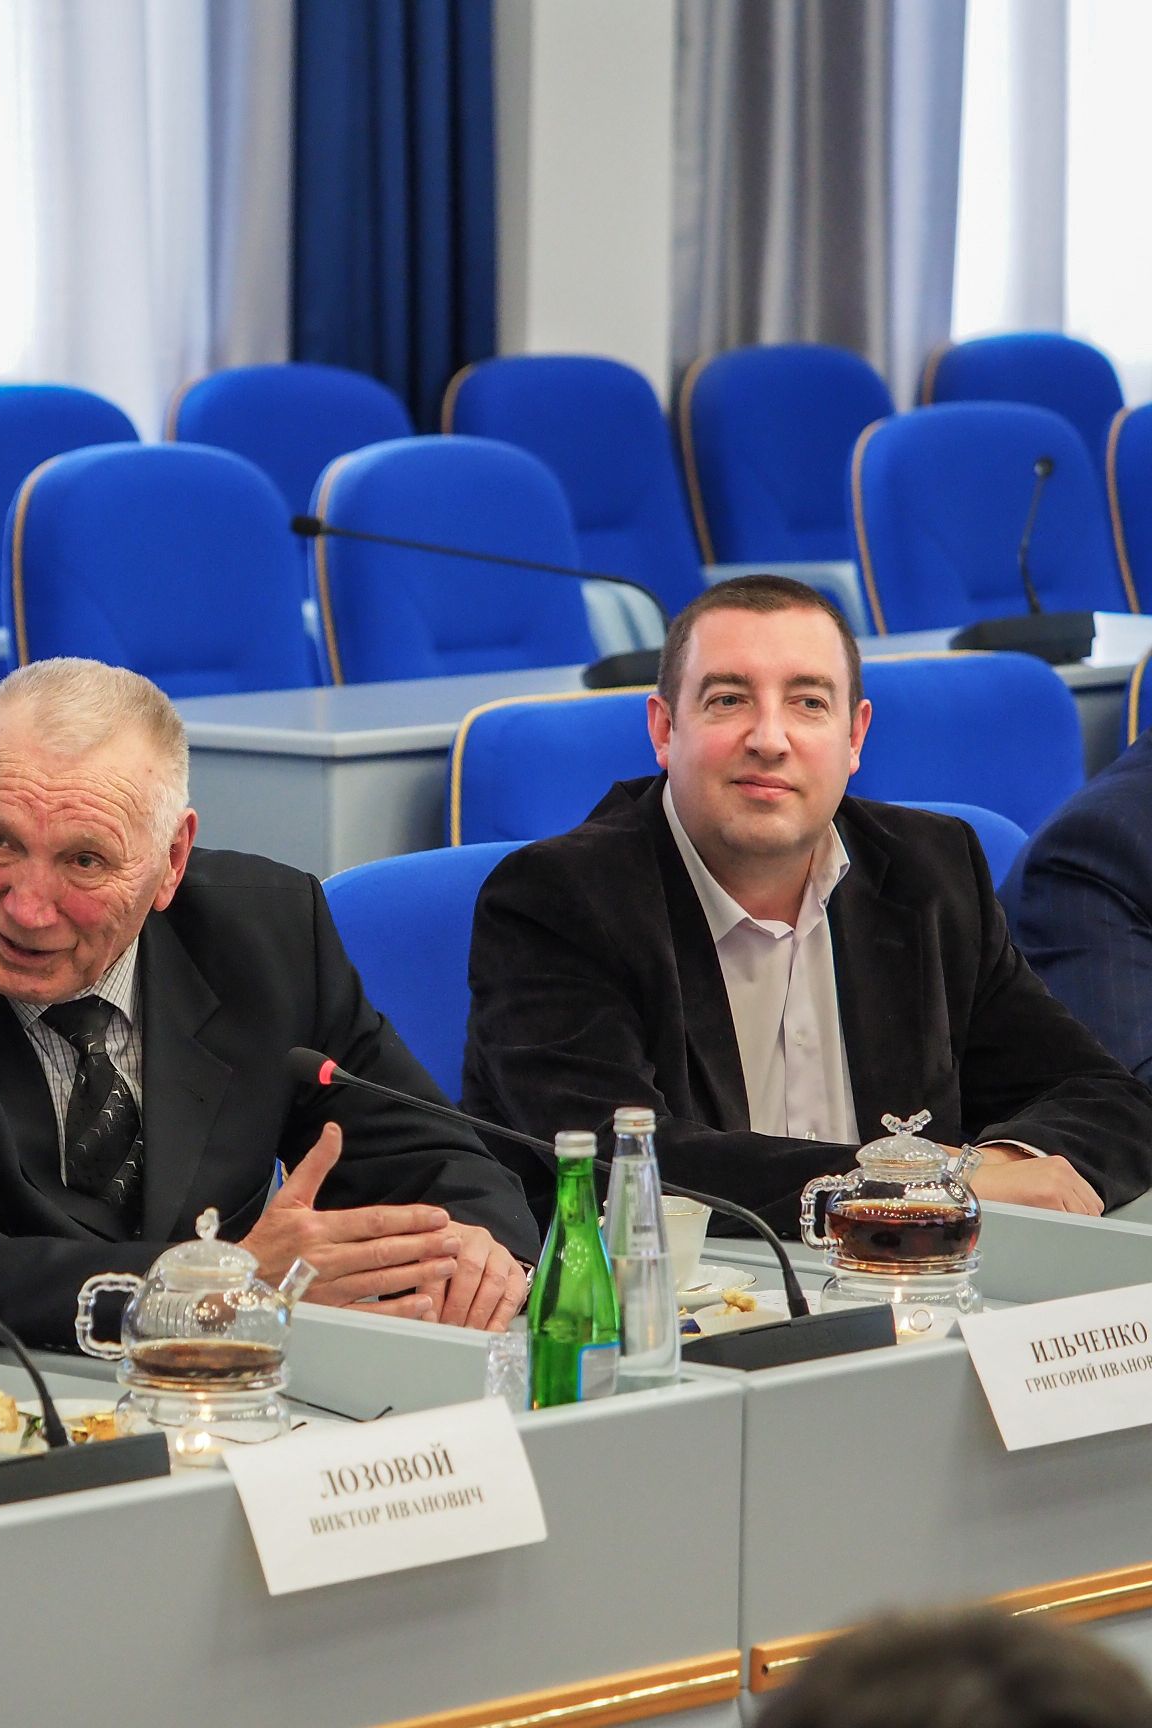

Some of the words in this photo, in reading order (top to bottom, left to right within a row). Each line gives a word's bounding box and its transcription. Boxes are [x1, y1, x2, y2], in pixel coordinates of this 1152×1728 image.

[1030, 1321, 1148, 1363] ИЛЬЧЕНКО
[1024, 1364, 1098, 1393] ГРИГОРИЙ
[320, 1443, 455, 1498] ЛОЗОВОЙ
[309, 1506, 380, 1535] ВИКТОР
[387, 1486, 485, 1521] ИВАНОВИЧ
